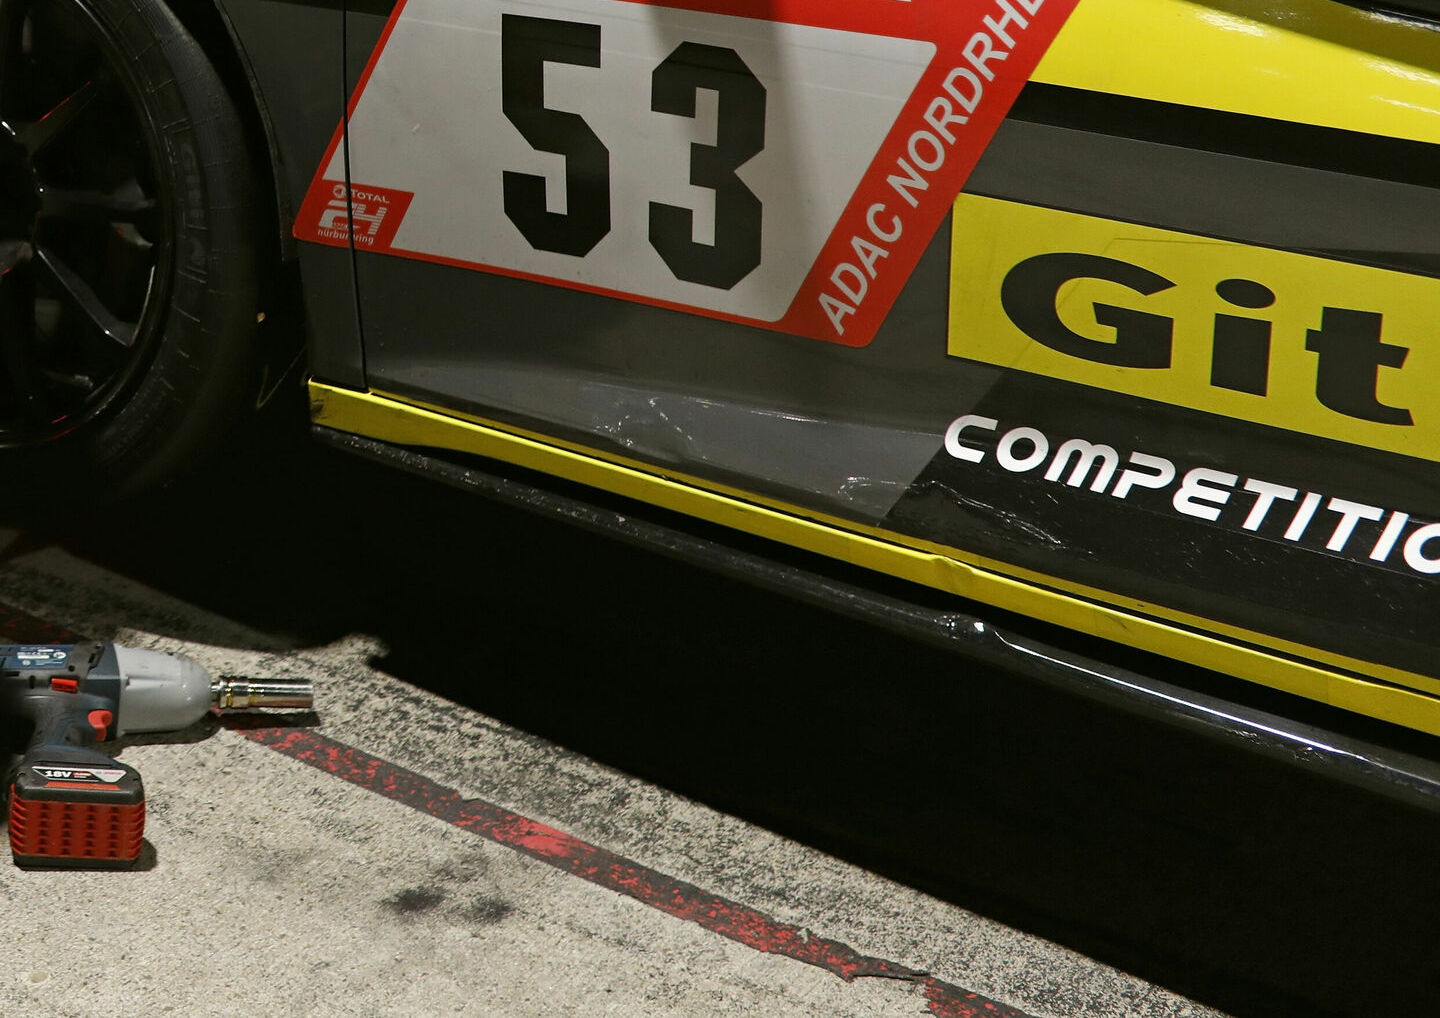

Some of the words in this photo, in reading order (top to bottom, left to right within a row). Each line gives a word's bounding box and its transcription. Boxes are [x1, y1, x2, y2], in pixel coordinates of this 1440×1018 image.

[350, 188, 390, 204] TOTAL
[501, 12, 768, 292] 53
[816, 202, 903, 336] ADAC
[1000, 251, 1415, 427] Git
[944, 413, 1440, 576] COMPETITIO
[44, 769, 72, 779] 18V
